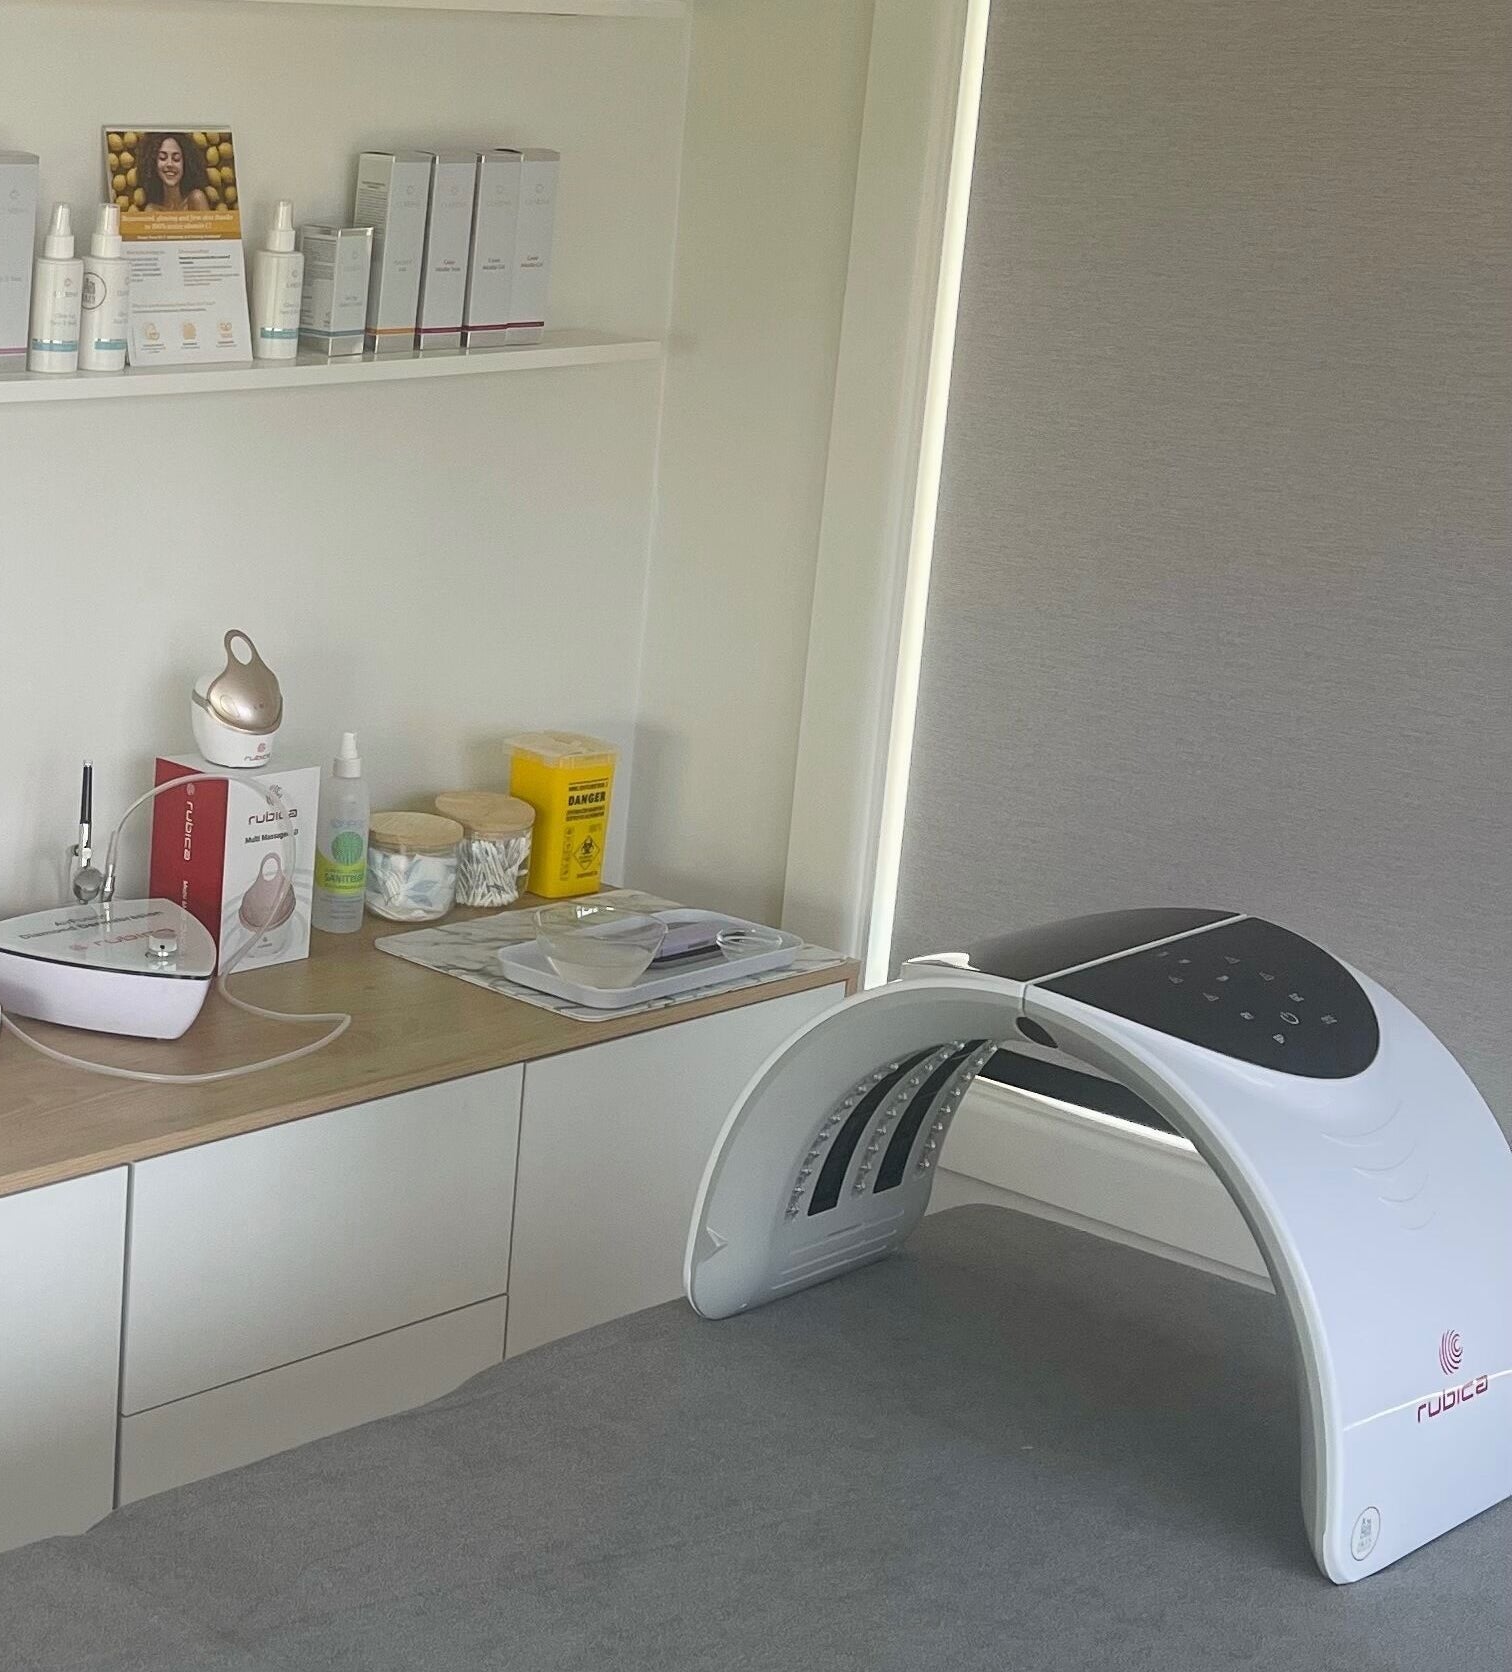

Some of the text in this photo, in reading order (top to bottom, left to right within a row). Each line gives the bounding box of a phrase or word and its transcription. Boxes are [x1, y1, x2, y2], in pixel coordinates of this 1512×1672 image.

[569, 791, 606, 806] DANGER
[183, 800, 195, 862] rubica
[261, 832, 291, 841] Massage
[1417, 1375, 1488, 1422] rubica
